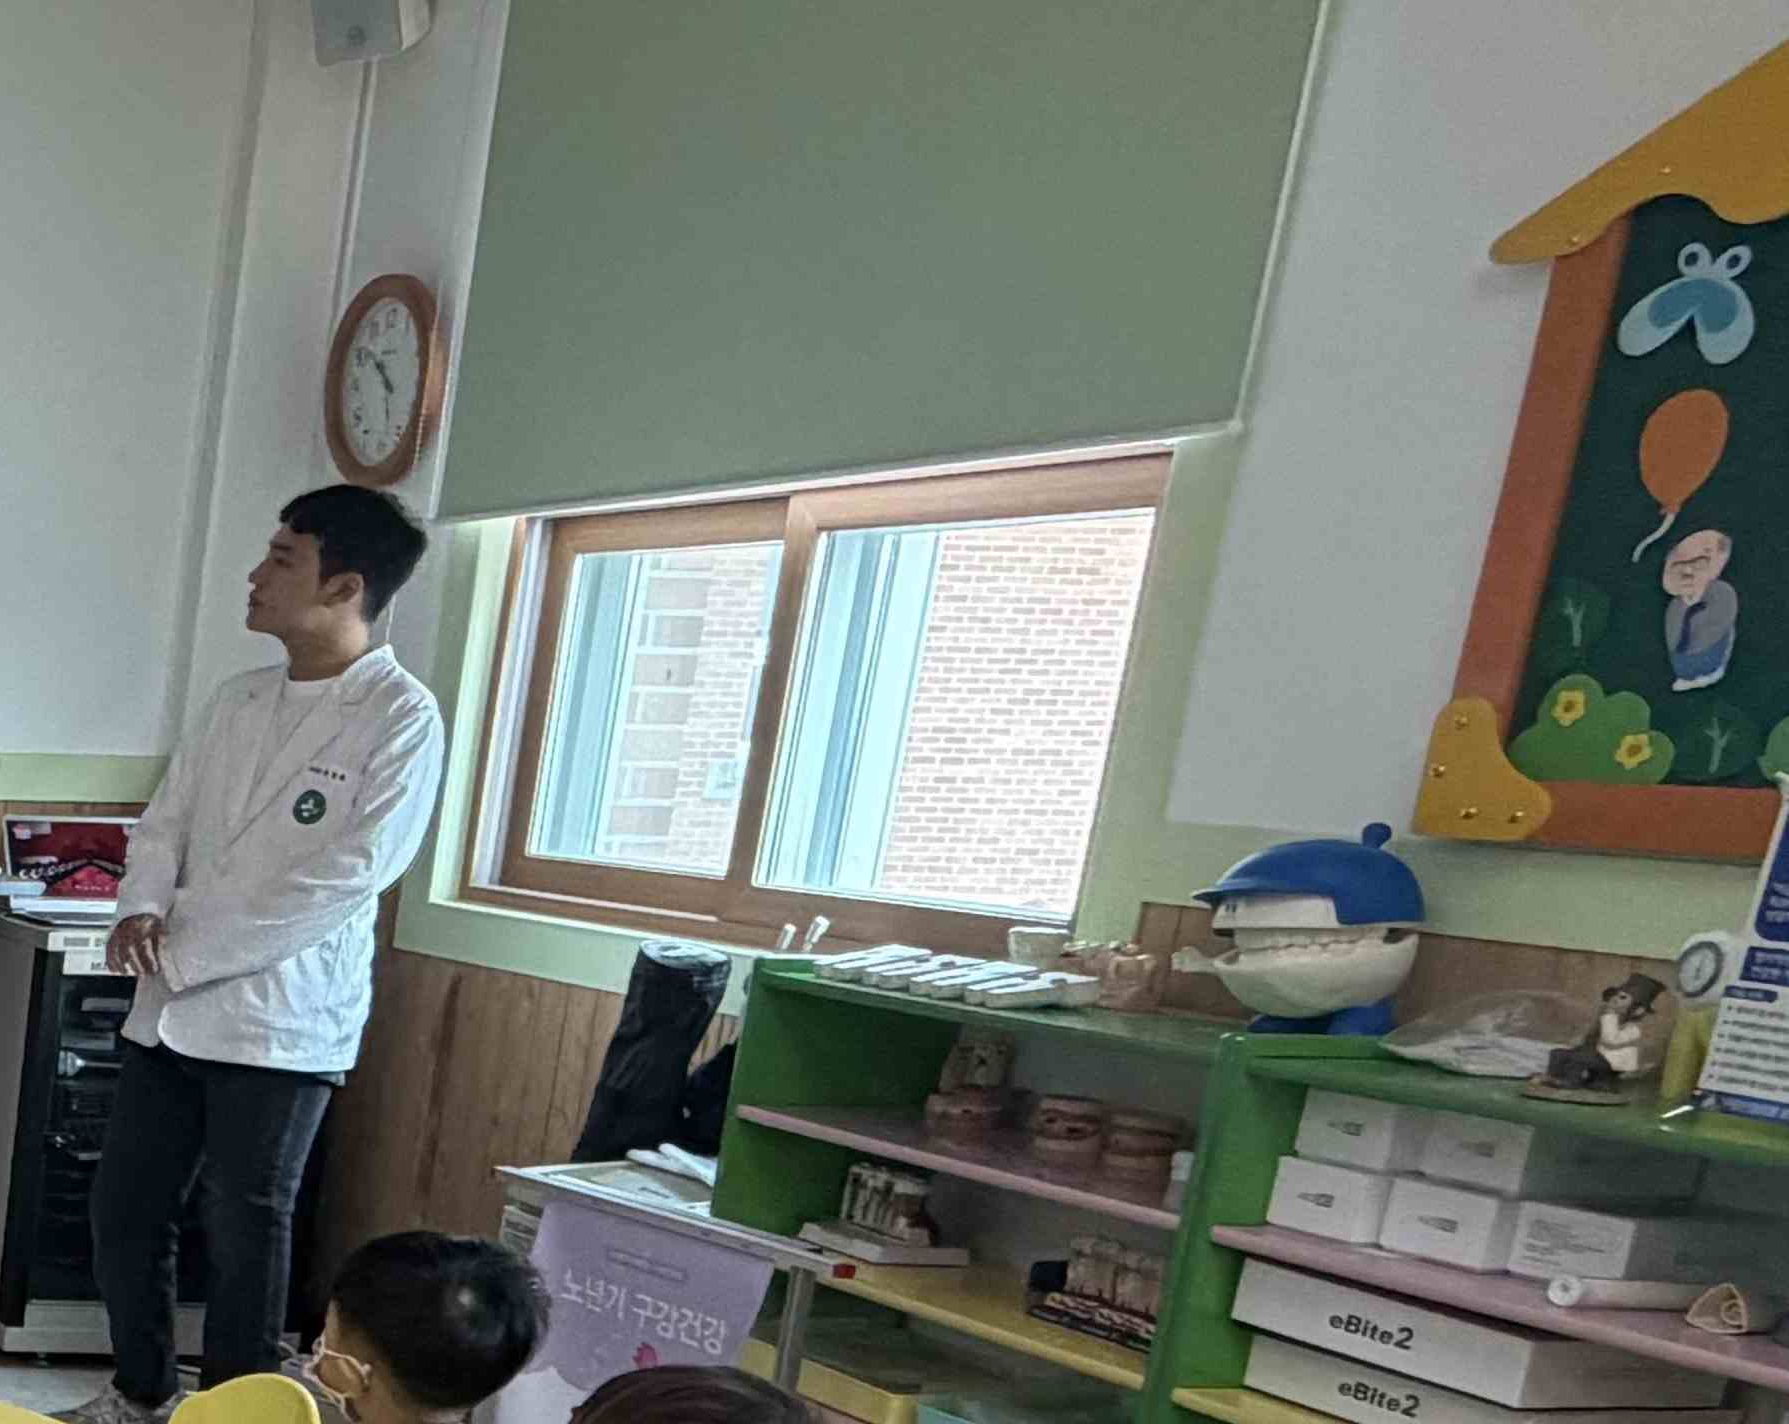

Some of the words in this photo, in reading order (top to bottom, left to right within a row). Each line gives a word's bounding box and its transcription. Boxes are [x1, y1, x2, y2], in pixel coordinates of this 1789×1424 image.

[559, 1266, 626, 1321] 노년기
[632, 1292, 725, 1355] 구강건강
[1329, 1313, 1414, 1350] eBite2
[1338, 1381, 1421, 1418] eBite2
